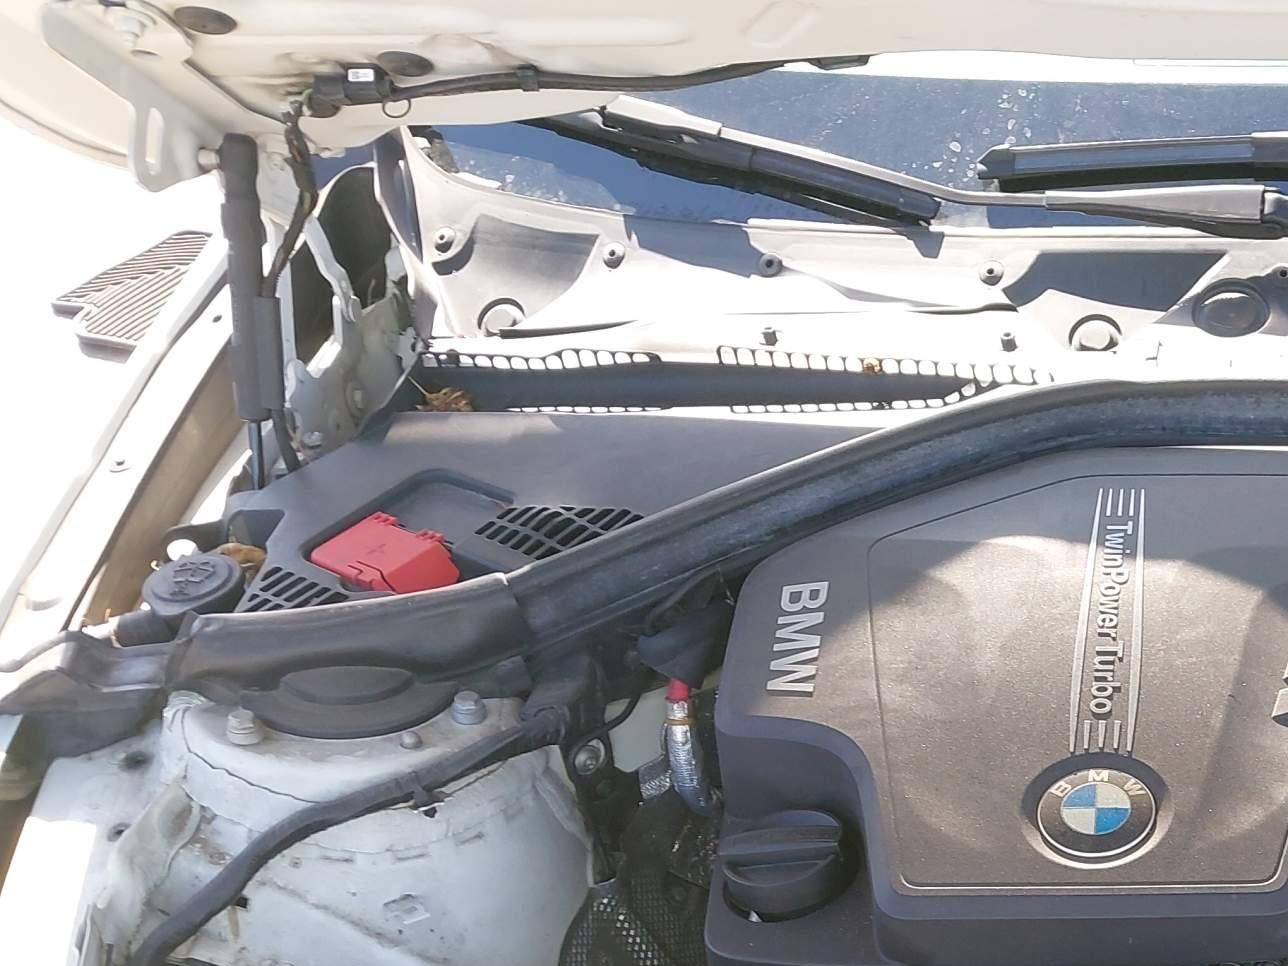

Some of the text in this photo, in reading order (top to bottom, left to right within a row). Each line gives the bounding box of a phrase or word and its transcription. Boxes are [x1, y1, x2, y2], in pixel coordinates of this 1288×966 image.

[766, 581, 829, 696] BMW
[1088, 520, 1133, 714] TwinPower Turbo
[1050, 769, 1147, 799] BMW
